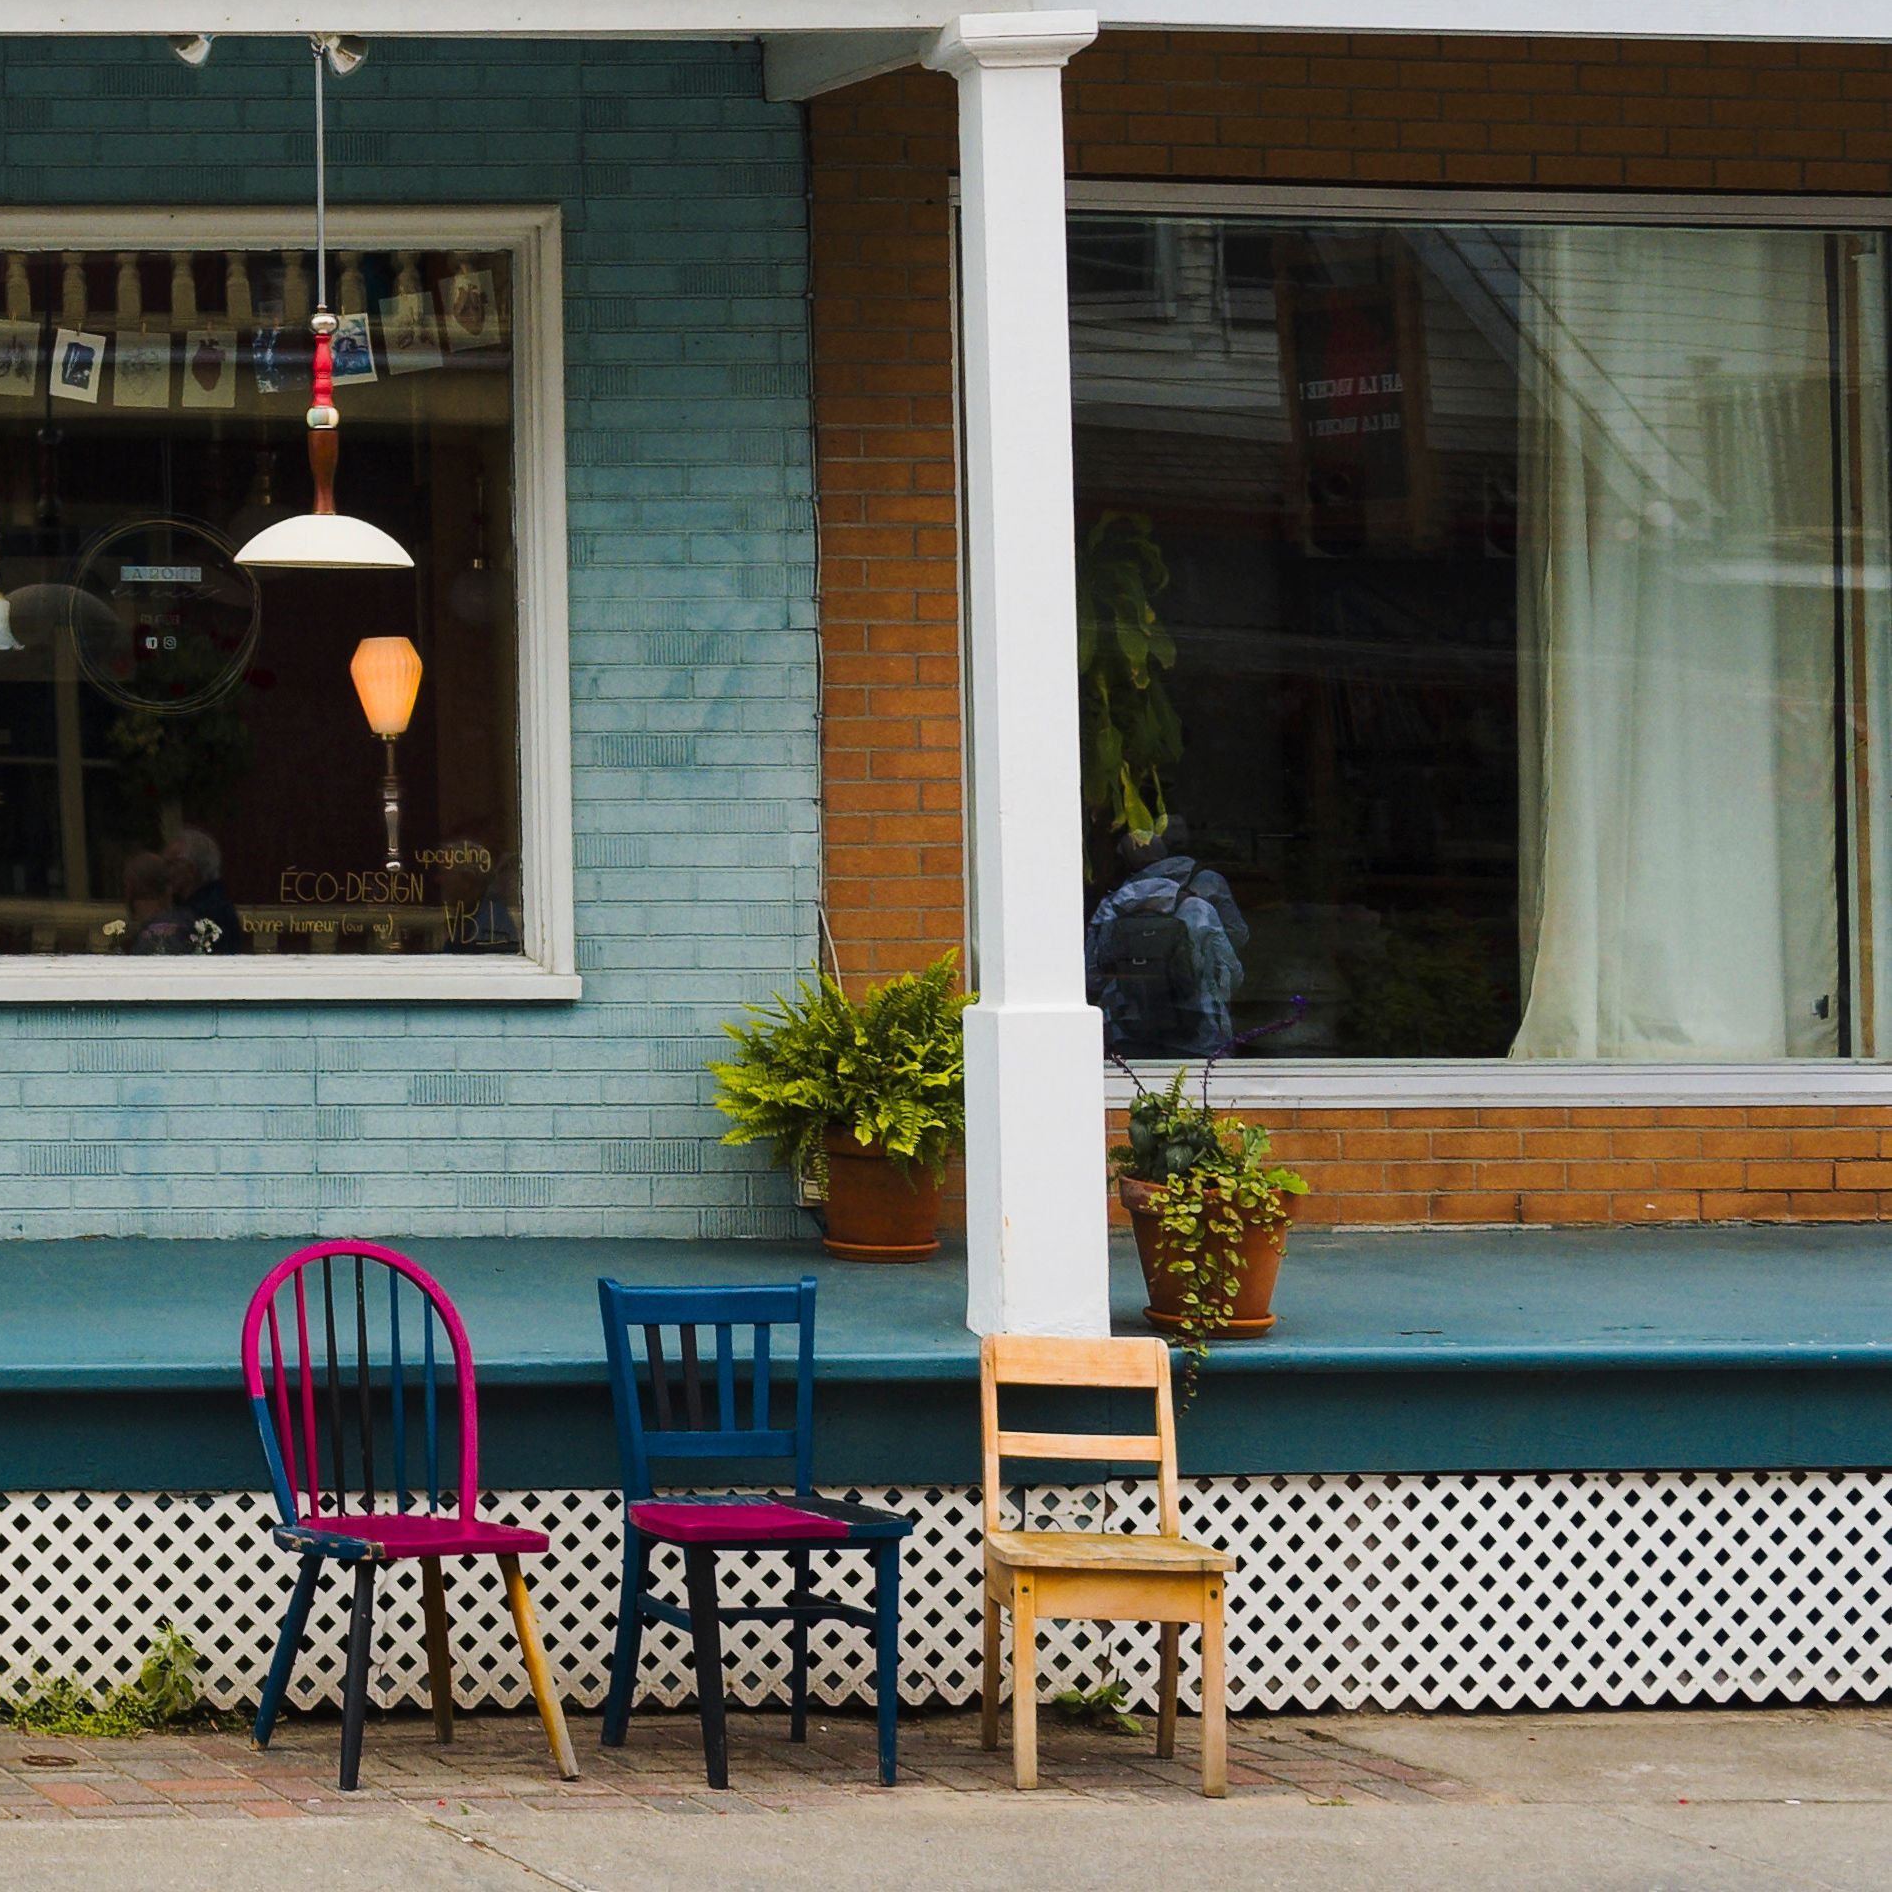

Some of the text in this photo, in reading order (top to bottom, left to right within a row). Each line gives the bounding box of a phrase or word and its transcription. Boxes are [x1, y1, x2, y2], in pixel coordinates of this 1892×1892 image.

[280, 865, 424, 904] ÉCO-DESIGN
[242, 913, 283, 933] bonne
[289, 913, 339, 933] humeur
